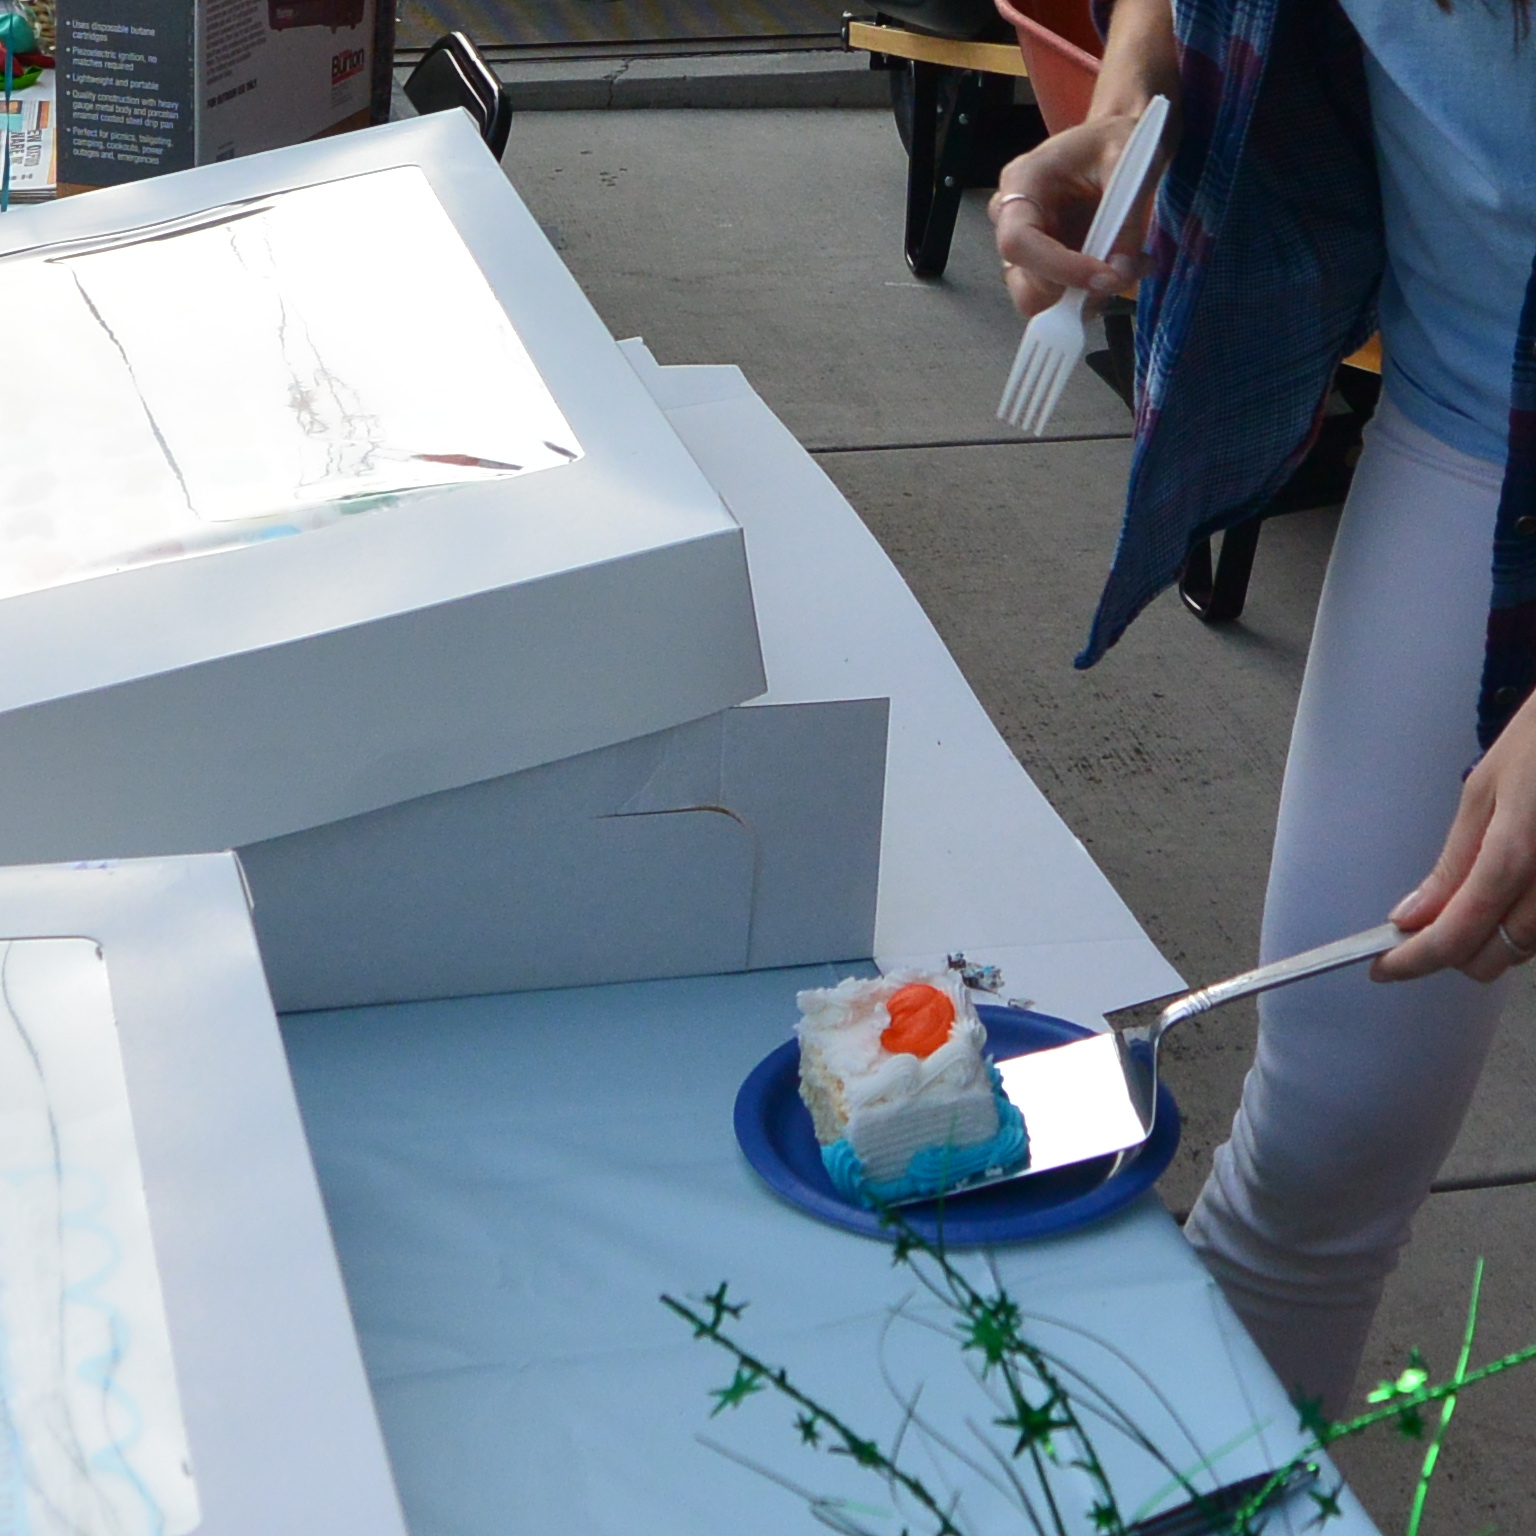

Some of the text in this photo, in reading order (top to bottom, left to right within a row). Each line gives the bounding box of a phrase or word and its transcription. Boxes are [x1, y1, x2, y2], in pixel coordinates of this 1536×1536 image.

[72, 20, 89, 29] Uses
[91, 23, 129, 34] disposable
[72, 31, 108, 43] cartridges
[332, 48, 364, 78] Burton
[72, 73, 159, 90] Lightweight and portable
[72, 90, 96, 101] Quality
[97, 94, 139, 104] construction
[73, 126, 98, 137] Perfect
